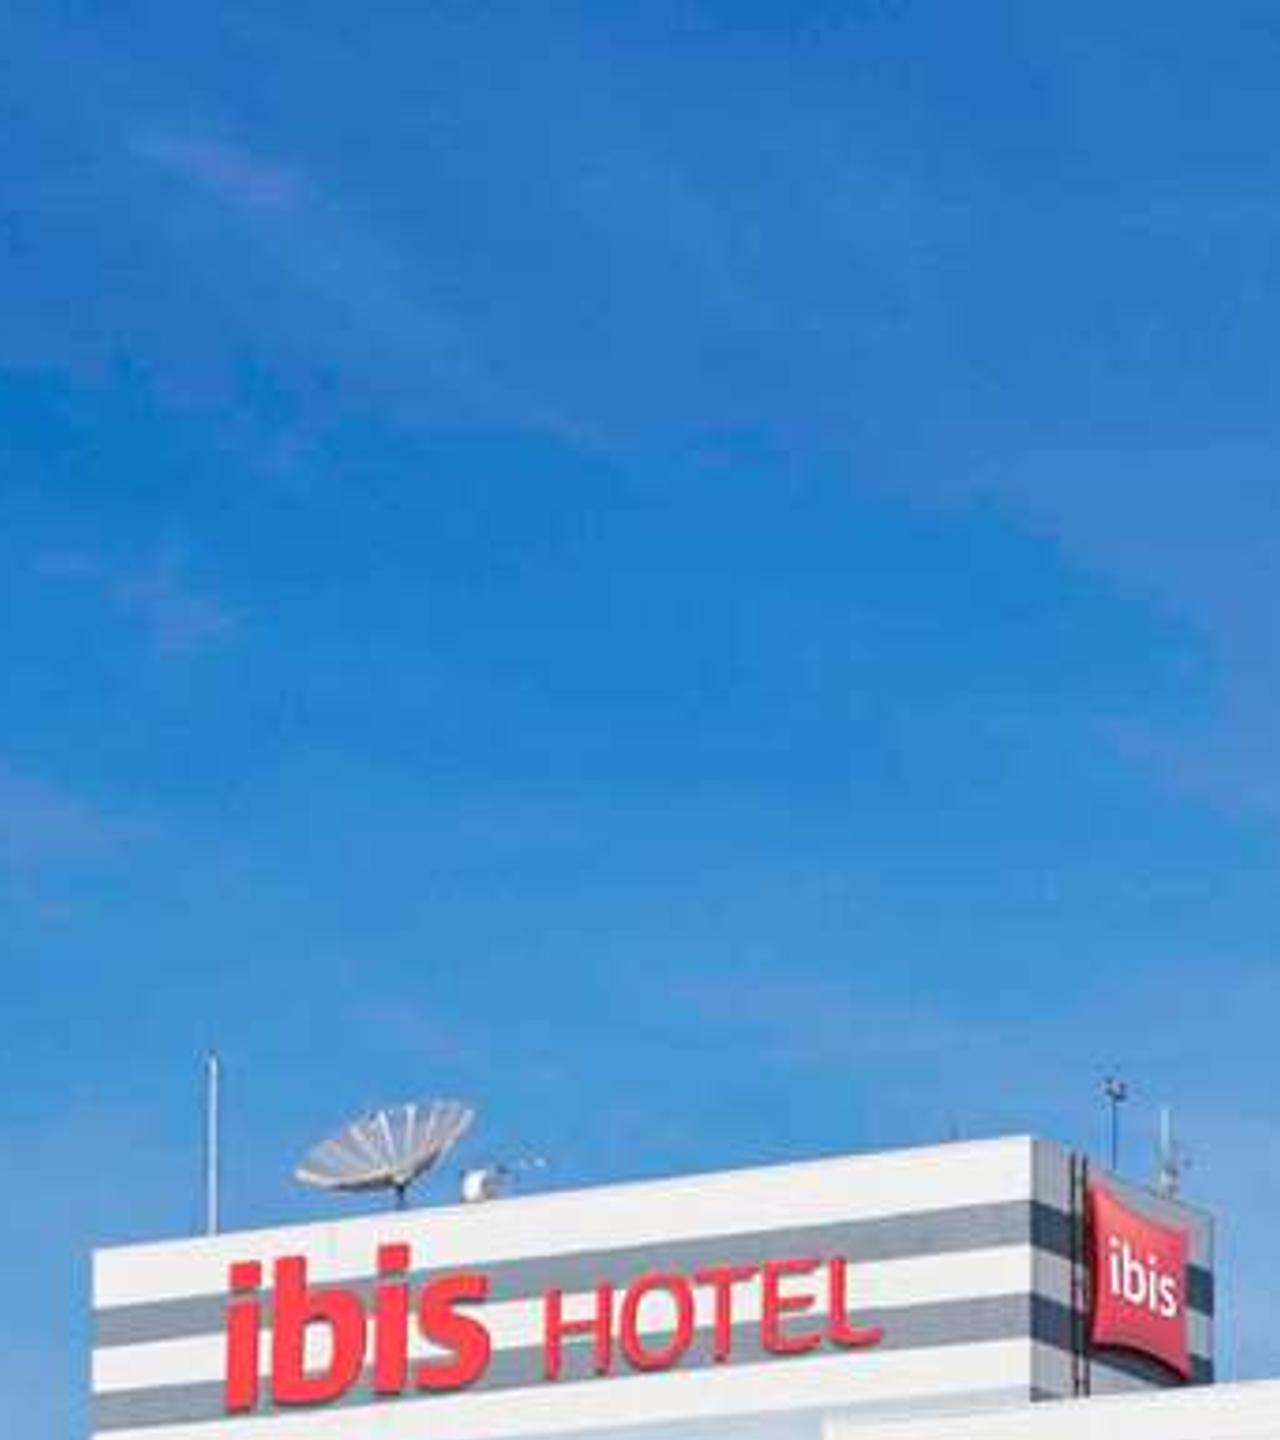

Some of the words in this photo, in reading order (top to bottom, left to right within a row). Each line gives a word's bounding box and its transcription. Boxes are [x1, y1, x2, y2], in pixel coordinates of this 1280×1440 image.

[224, 1243, 491, 1414] ibis
[544, 1257, 883, 1380] HOTEL
[1107, 1236, 1179, 1318] ibis
